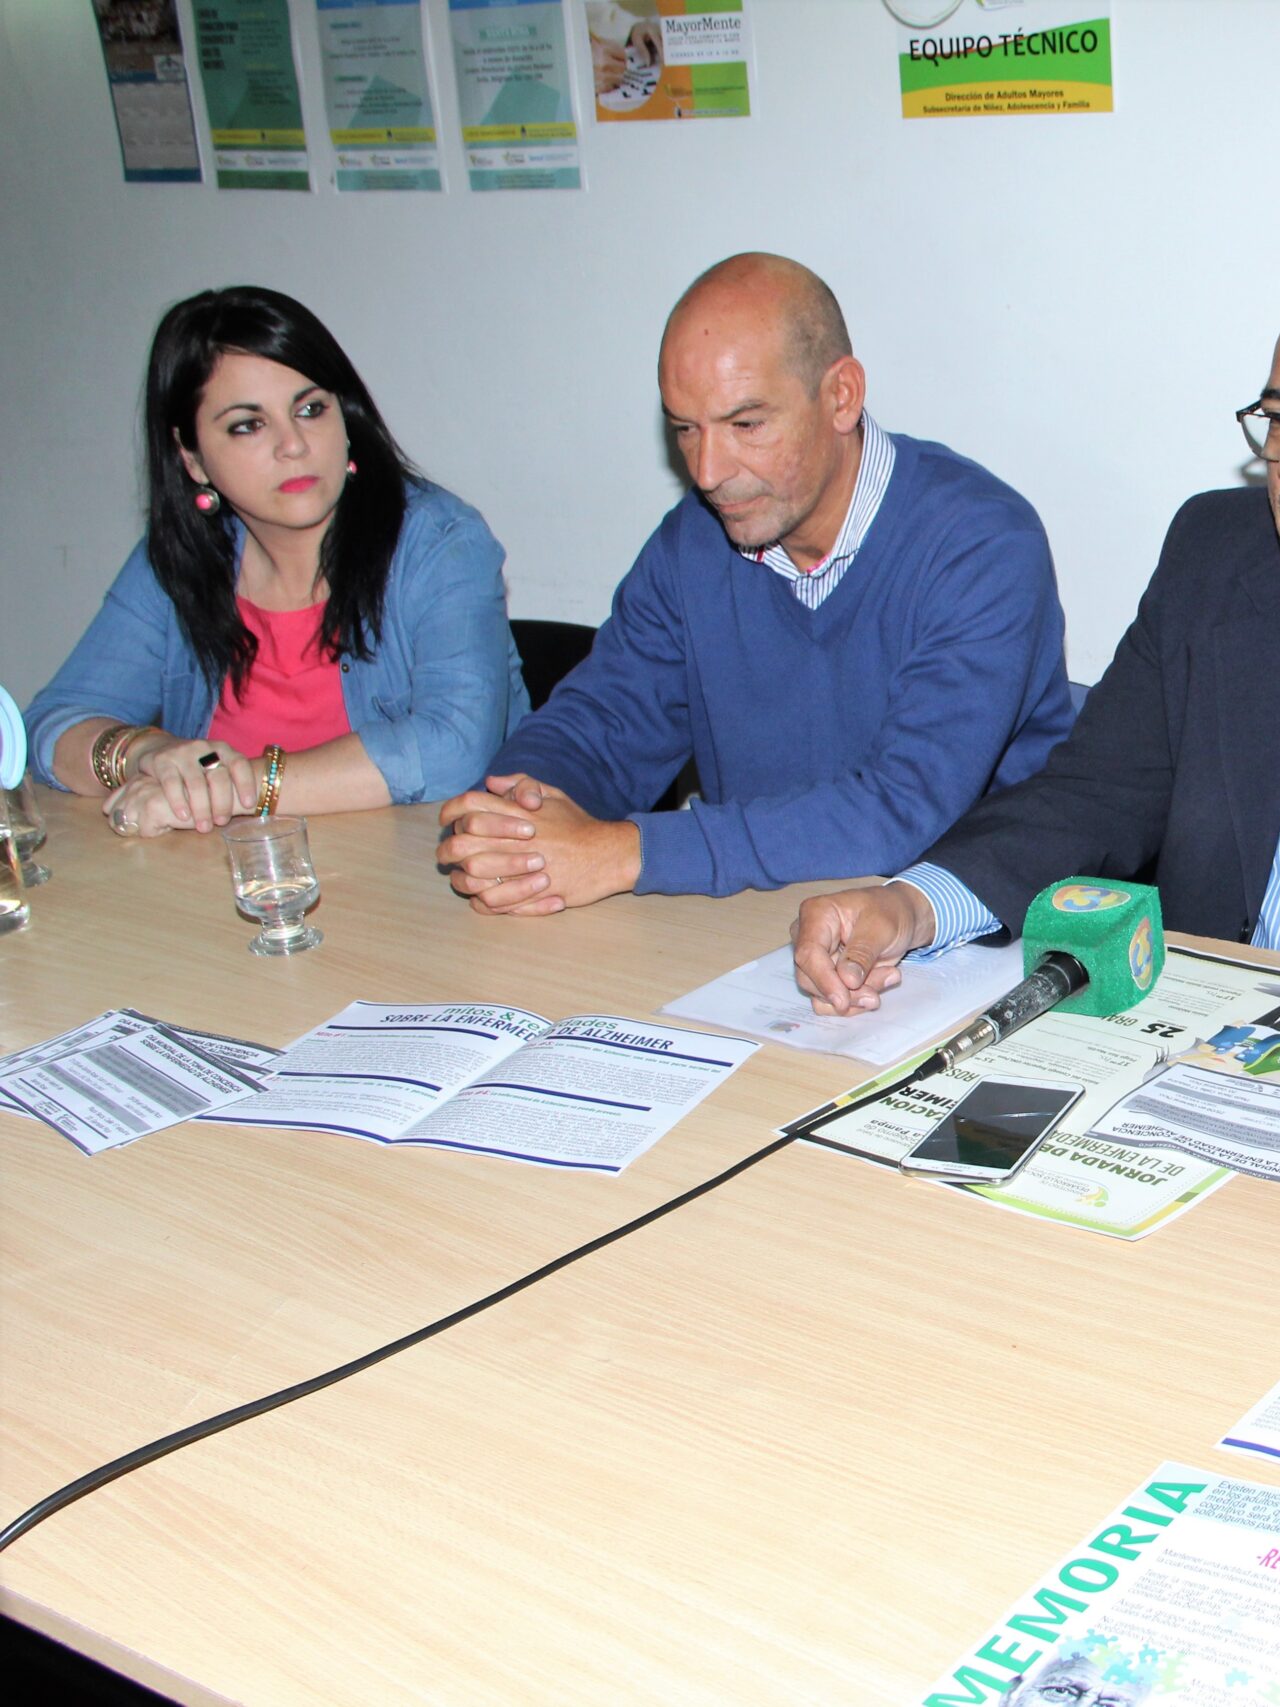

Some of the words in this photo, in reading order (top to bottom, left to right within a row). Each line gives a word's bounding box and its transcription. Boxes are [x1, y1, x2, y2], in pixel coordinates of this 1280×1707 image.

[665, 17, 741, 35] MayorMente
[909, 35, 993, 67] EQUIPO
[998, 26, 1098, 57] TÉCNICO
[945, 91, 982, 102] Dirección
[984, 91, 995, 100] de
[997, 90, 1027, 100] Adultos
[1029, 89, 1064, 100] Mayores
[1063, 100, 1090, 109] Familia
[442, 1006, 496, 1017] mitos
[499, 1010, 516, 1022] &
[379, 1014, 433, 1023] SOBRE
[432, 1014, 453, 1023] LA
[557, 1026, 580, 1036] DE
[581, 1026, 675, 1051] ALZHEIMER
[1139, 1022, 1185, 1039] 25
[870, 1119, 910, 1136] Pampa
[1112, 1126, 1172, 1138] CONCIENCIA
[1121, 1122, 1178, 1136] ALZHEIMER
[1038, 1142, 1070, 1157] DE
[1048, 1130, 1141, 1163] ENFERMEDA
[1194, 1140, 1265, 1164] ENFERMEDAD
[1069, 1151, 1169, 1186] JORNADA
[1135, 1155, 1164, 1170] LA
[1157, 1163, 1187, 1177] DE
[1217, 1480, 1257, 1496] Existen
[1205, 1493, 1247, 1509] medida
[1252, 1503, 1268, 1513] en
[1241, 1493, 1280, 1510] adultos
[1199, 1500, 1246, 1518] cognitivo
[1246, 1509, 1272, 1523] será
[1215, 1511, 1257, 1530] algunos
[921, 1480, 1209, 1707] MEMORIA
